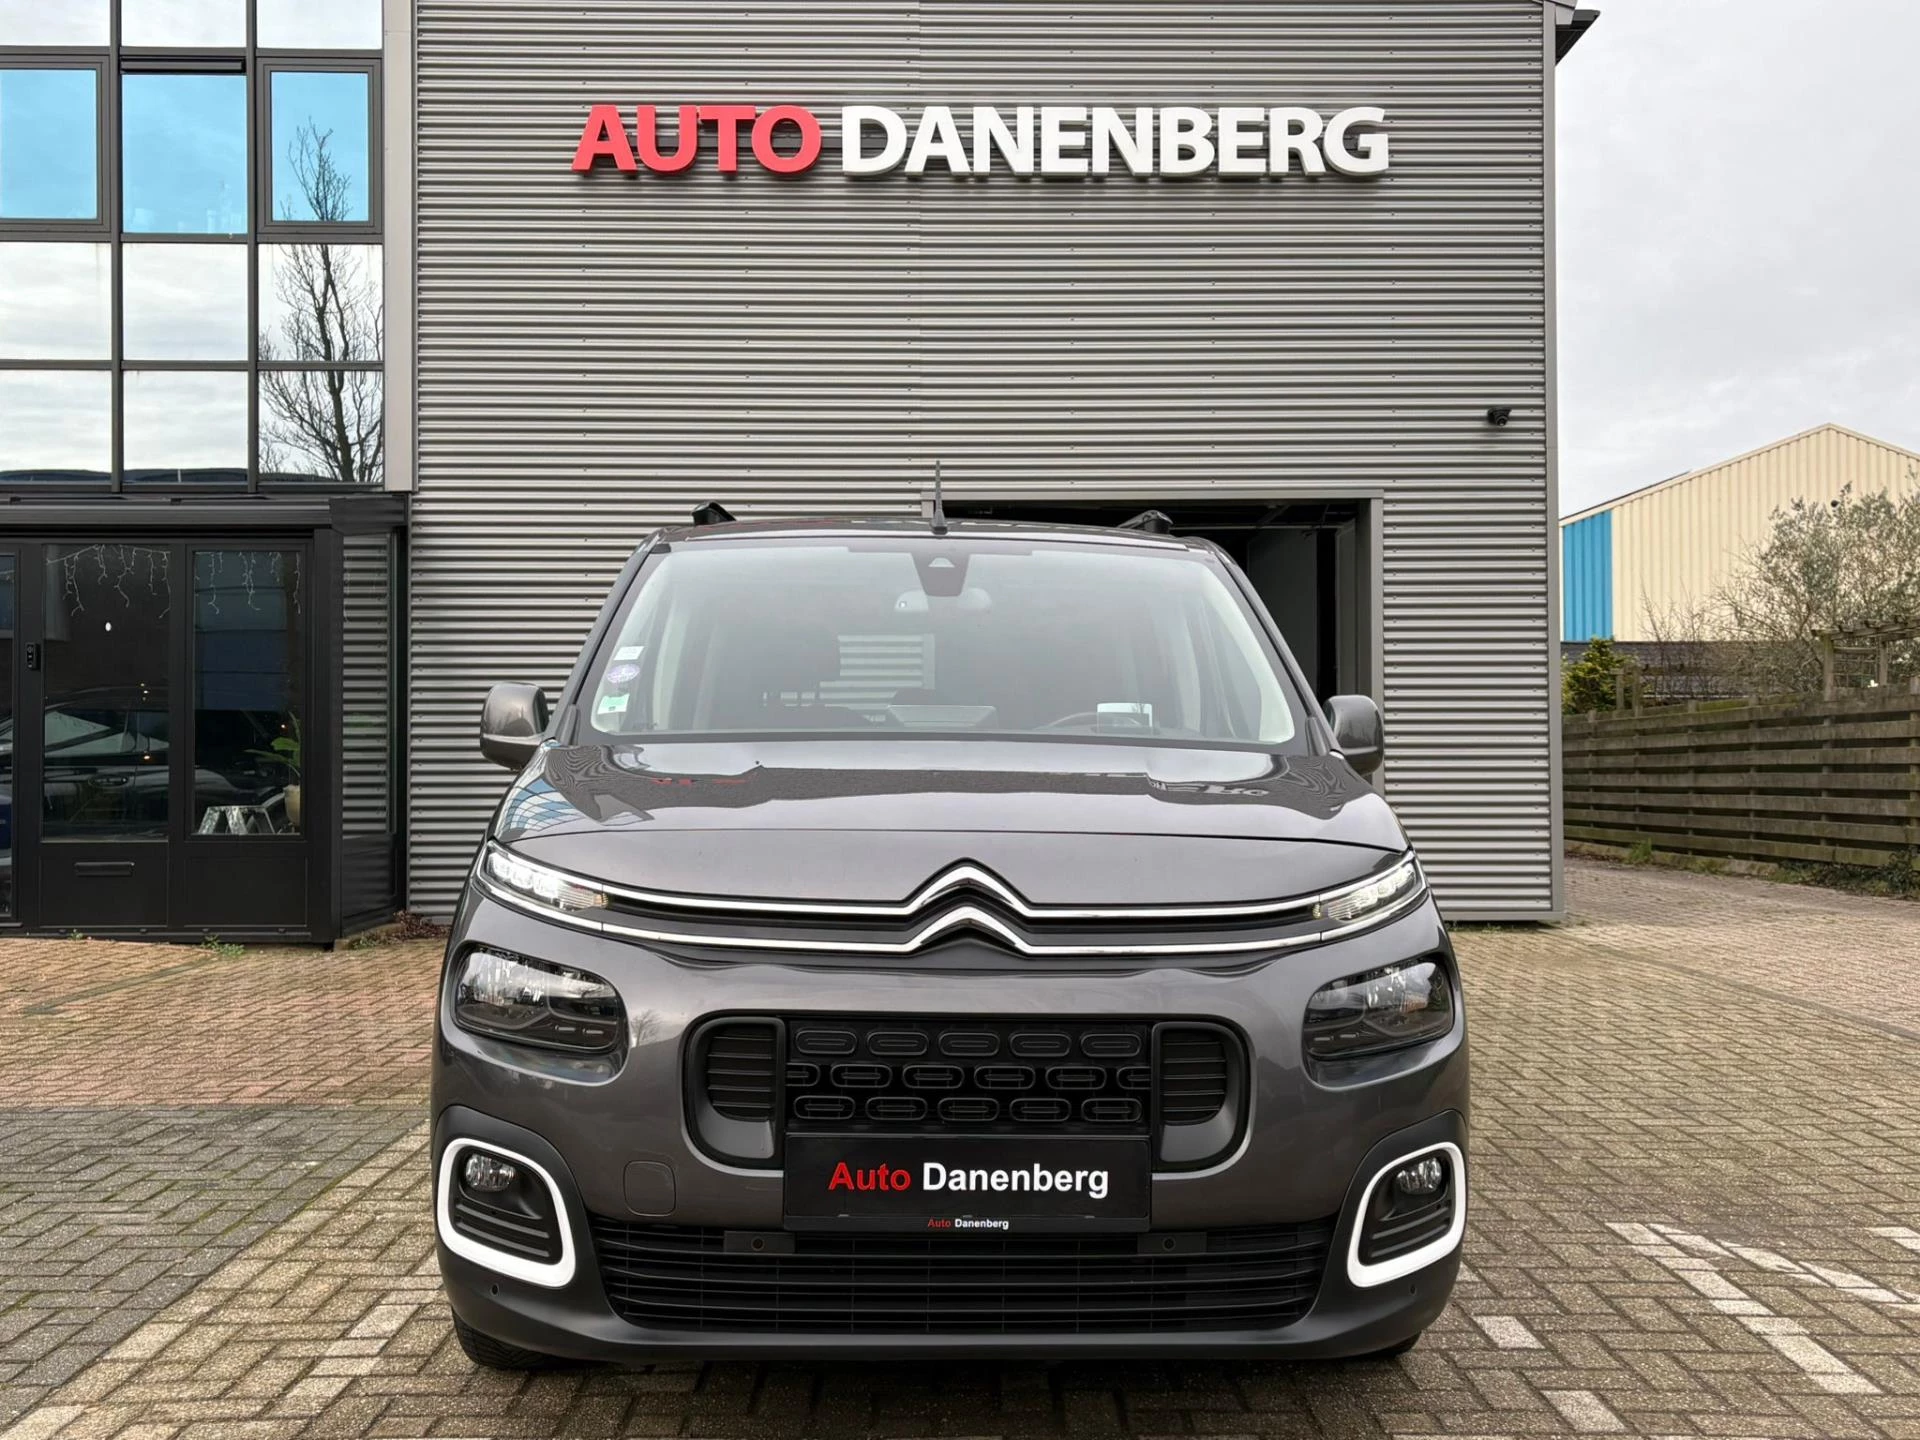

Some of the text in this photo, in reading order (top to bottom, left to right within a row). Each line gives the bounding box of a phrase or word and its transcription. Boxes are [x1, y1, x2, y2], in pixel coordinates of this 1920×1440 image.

[571, 104, 1390, 177] AUTO DANENBERG
[828, 1161, 1109, 1199] Auto Danenberg
[927, 1217, 1010, 1231] Auto Danenberg
